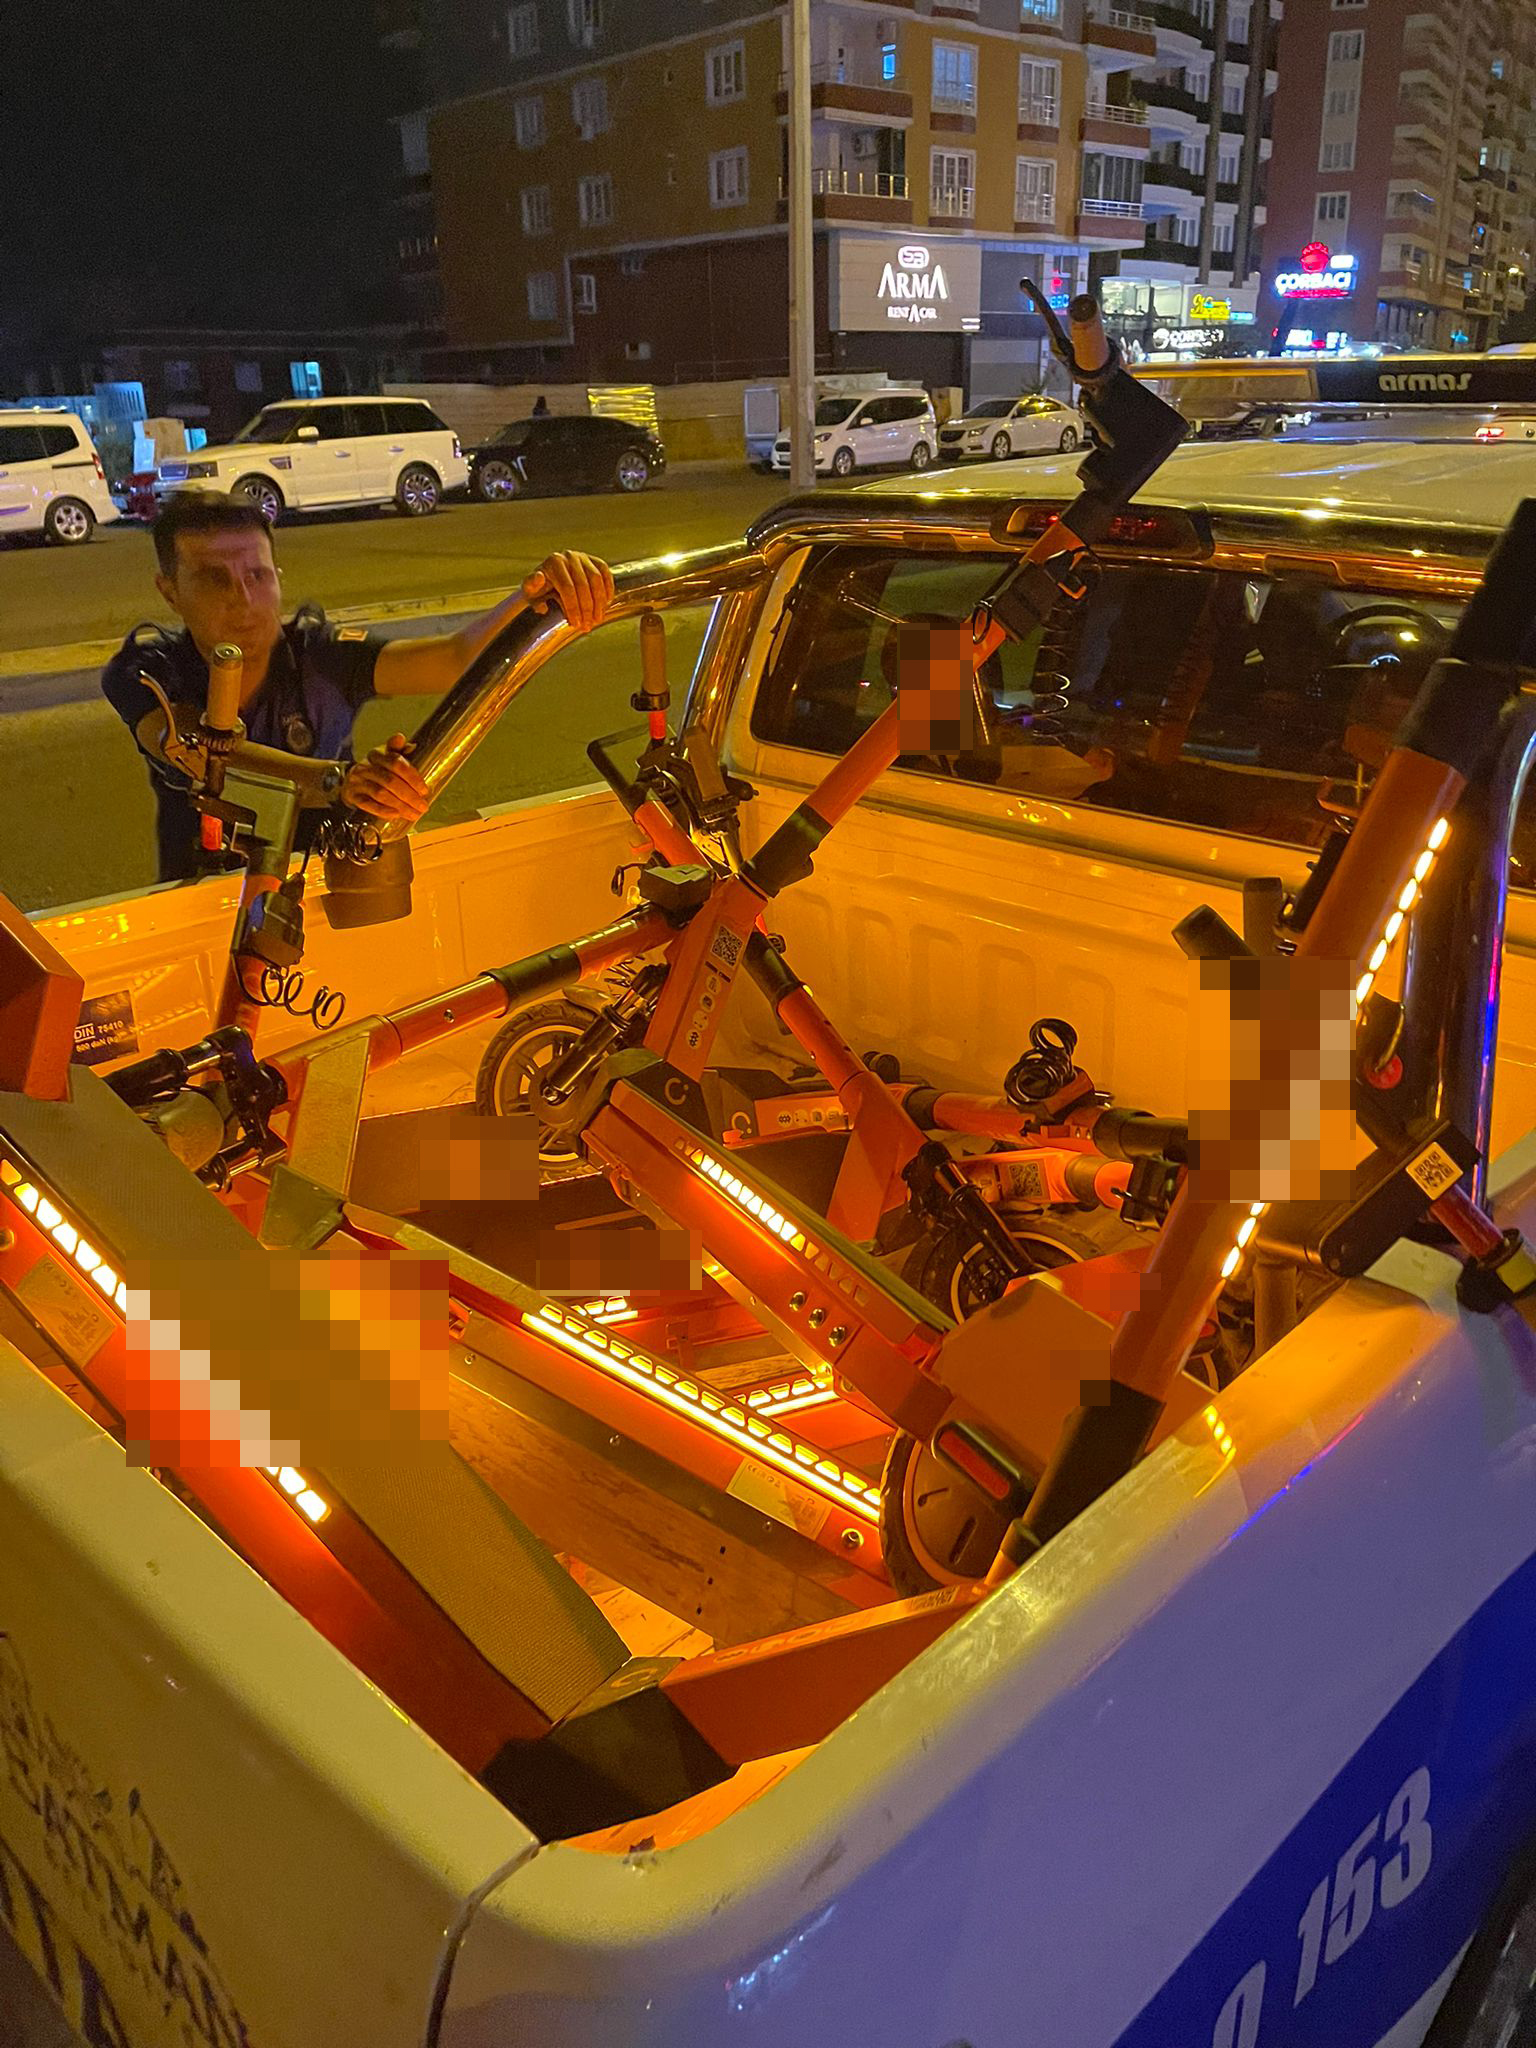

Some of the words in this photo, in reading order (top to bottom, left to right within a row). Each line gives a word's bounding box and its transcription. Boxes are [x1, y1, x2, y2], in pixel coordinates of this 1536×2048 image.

[877, 262, 948, 299] ARMA
[1379, 373, 1472, 392] armas
[74, 1026, 95, 1040] DIN
[97, 1020, 124, 1033] 75410
[1295, 1766, 1432, 2007] 153
